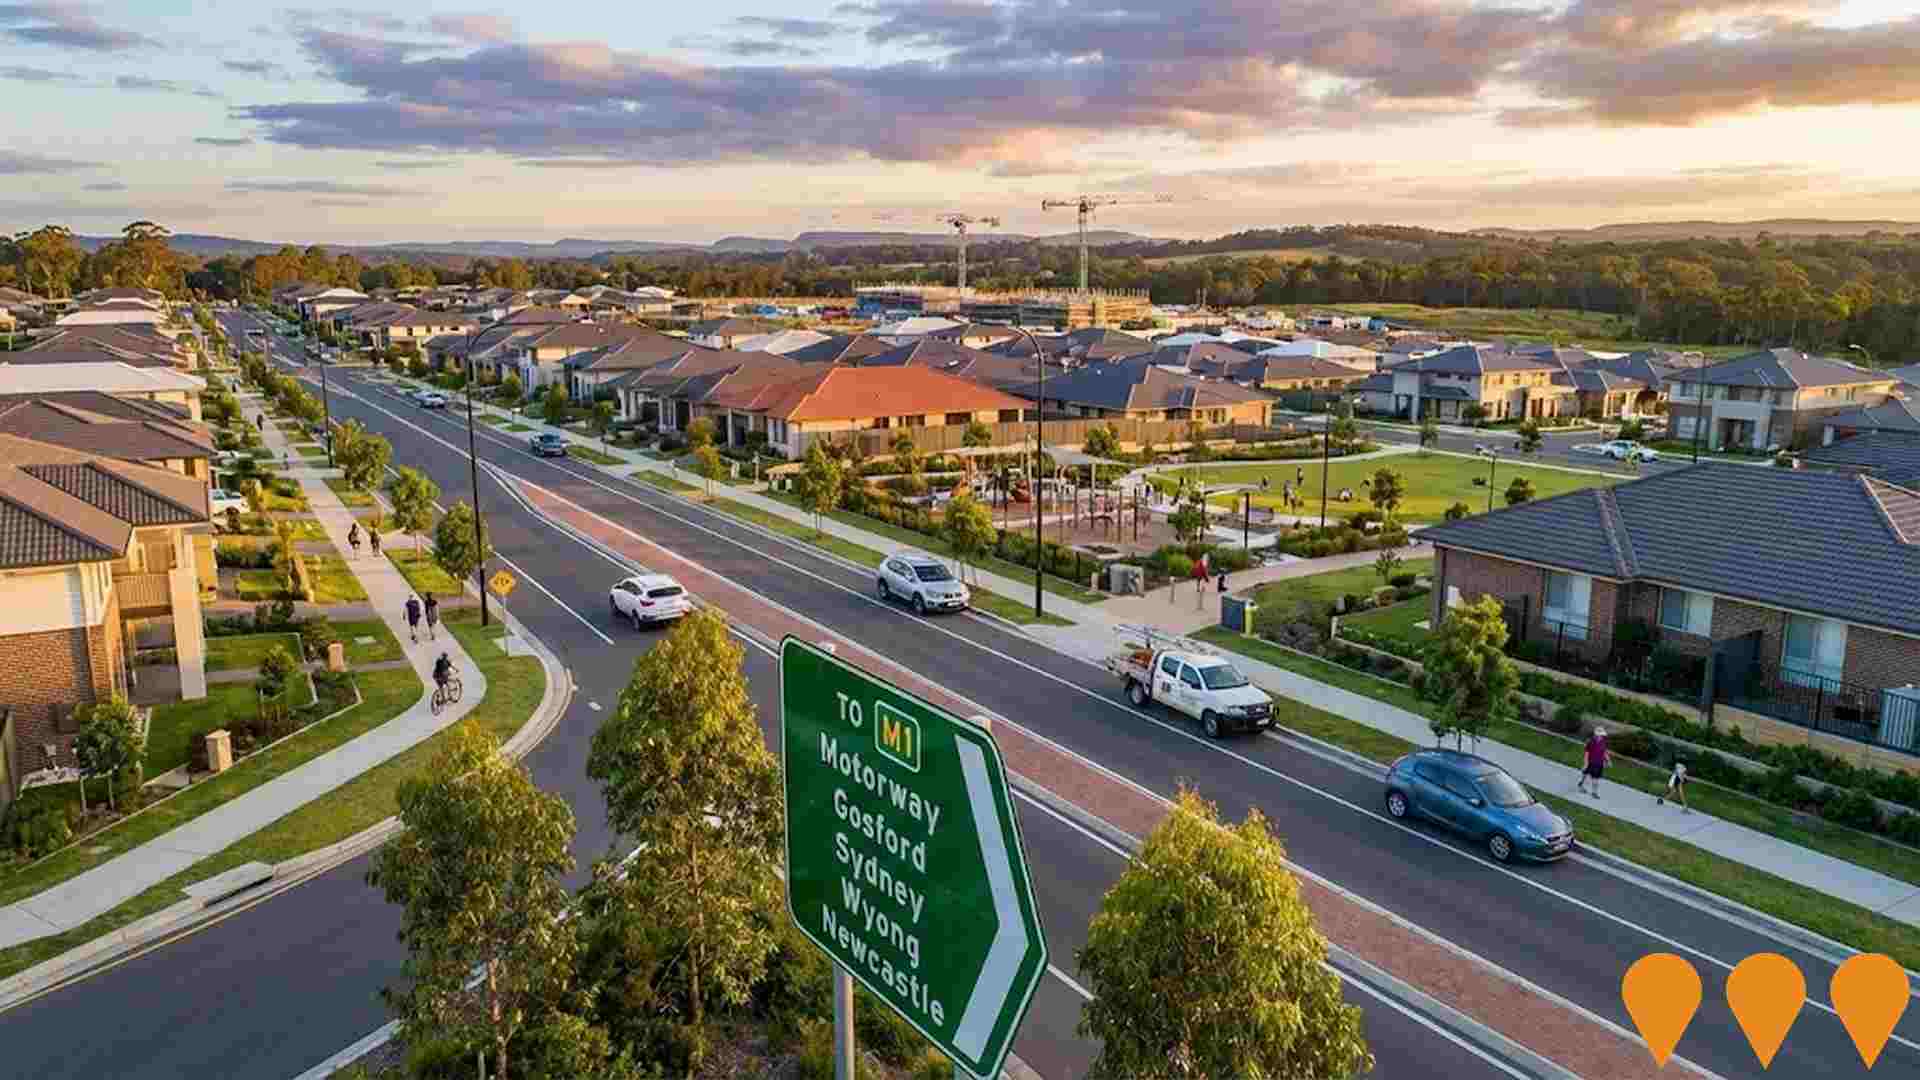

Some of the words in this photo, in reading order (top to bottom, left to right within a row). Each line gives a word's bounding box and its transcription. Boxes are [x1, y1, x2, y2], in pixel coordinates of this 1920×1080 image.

[836, 691, 863, 727] TO
[881, 715, 912, 757] M1
[818, 731, 940, 836] Motorway
[833, 789, 926, 873] Gosford
[835, 832, 925, 923] Sydney
[841, 876, 920, 969] Wyong
[821, 904, 945, 1028] Newcastle
